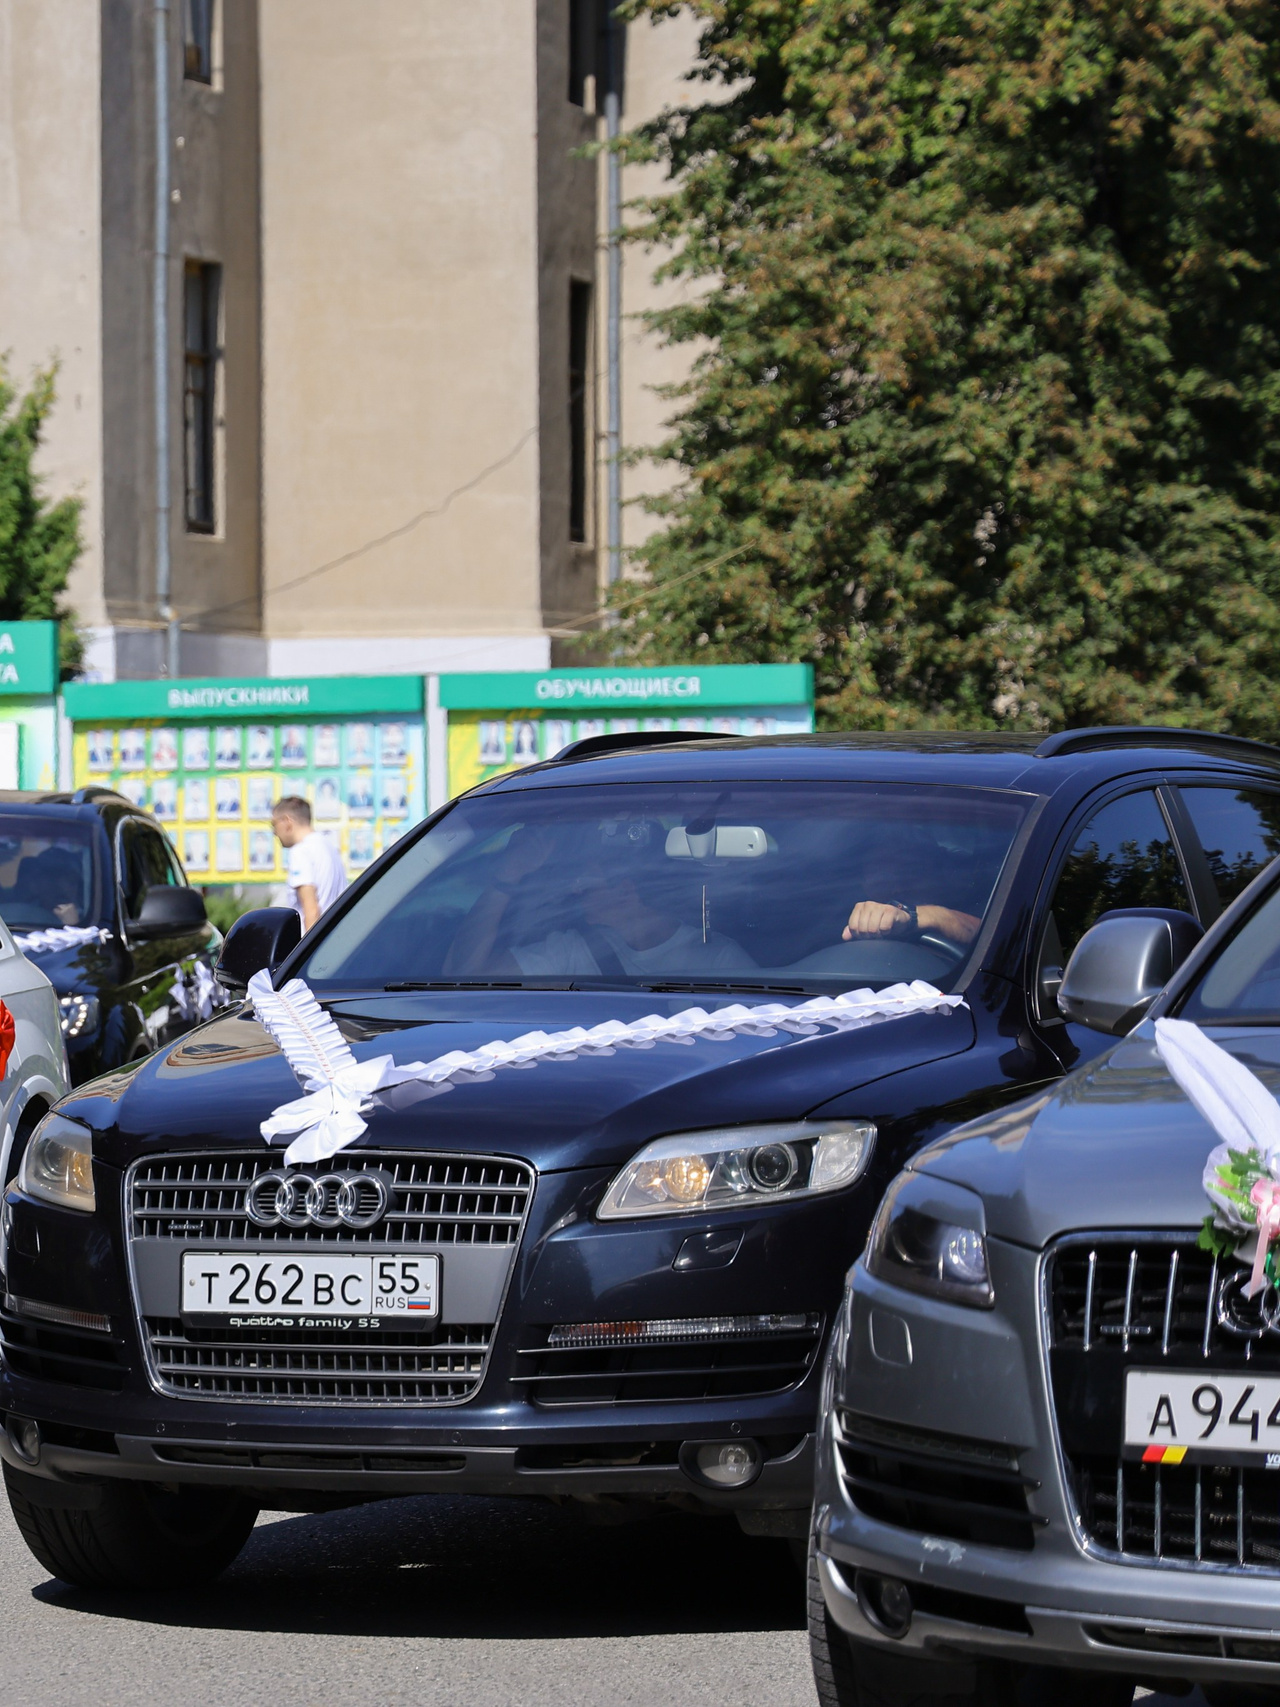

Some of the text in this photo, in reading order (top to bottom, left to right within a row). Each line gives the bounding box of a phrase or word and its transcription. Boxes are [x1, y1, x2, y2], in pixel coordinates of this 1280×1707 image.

[167, 686, 310, 707] ВЫПУСКНИКИ
[536, 676, 701, 699] ОБУЧАЮЩИЕСЯ
[378, 1262, 420, 1294] 55
[375, 1296, 406, 1310] RUS
[229, 1316, 381, 1330] quattro family 55
